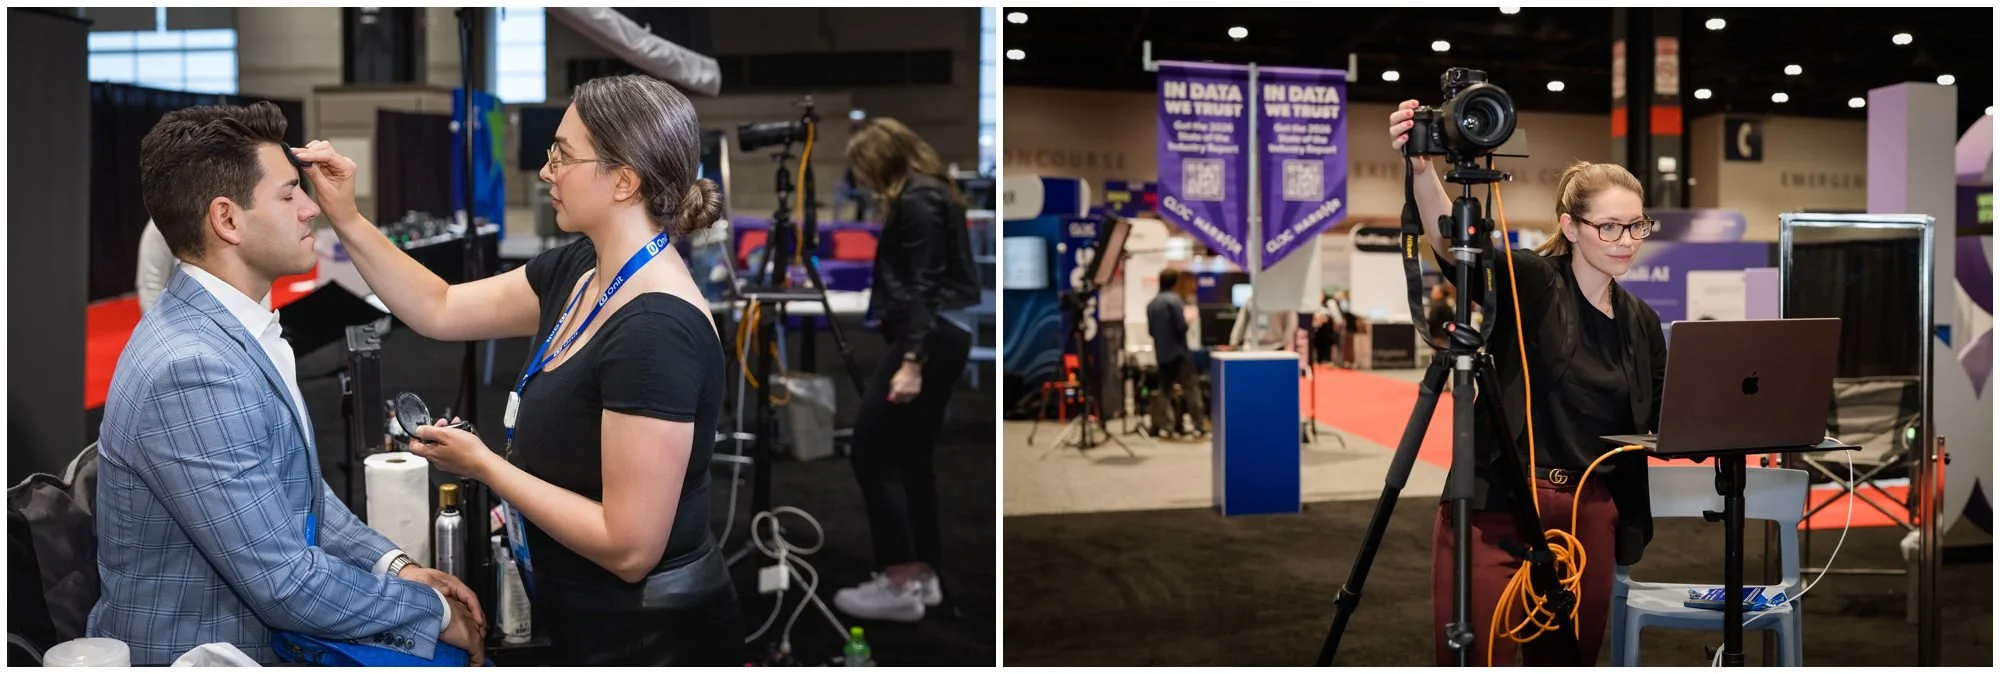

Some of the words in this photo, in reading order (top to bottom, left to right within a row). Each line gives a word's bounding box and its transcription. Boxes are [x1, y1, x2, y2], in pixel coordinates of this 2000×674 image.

[1163, 80, 1187, 99] IN
[1190, 82, 1243, 101] DATA
[1263, 84, 1286, 102] IN
[1288, 85, 1340, 104] DATA
[1164, 100, 1192, 115] WE
[1193, 101, 1244, 118] TRUST
[1264, 103, 1291, 117] WE
[1292, 104, 1341, 119] TRUST
[1781, 170, 1867, 189] EMERGEN
[1163, 196, 1194, 221] CLOC
[1266, 228, 1295, 253] CLOC
[607, 275, 624, 295] Onit
